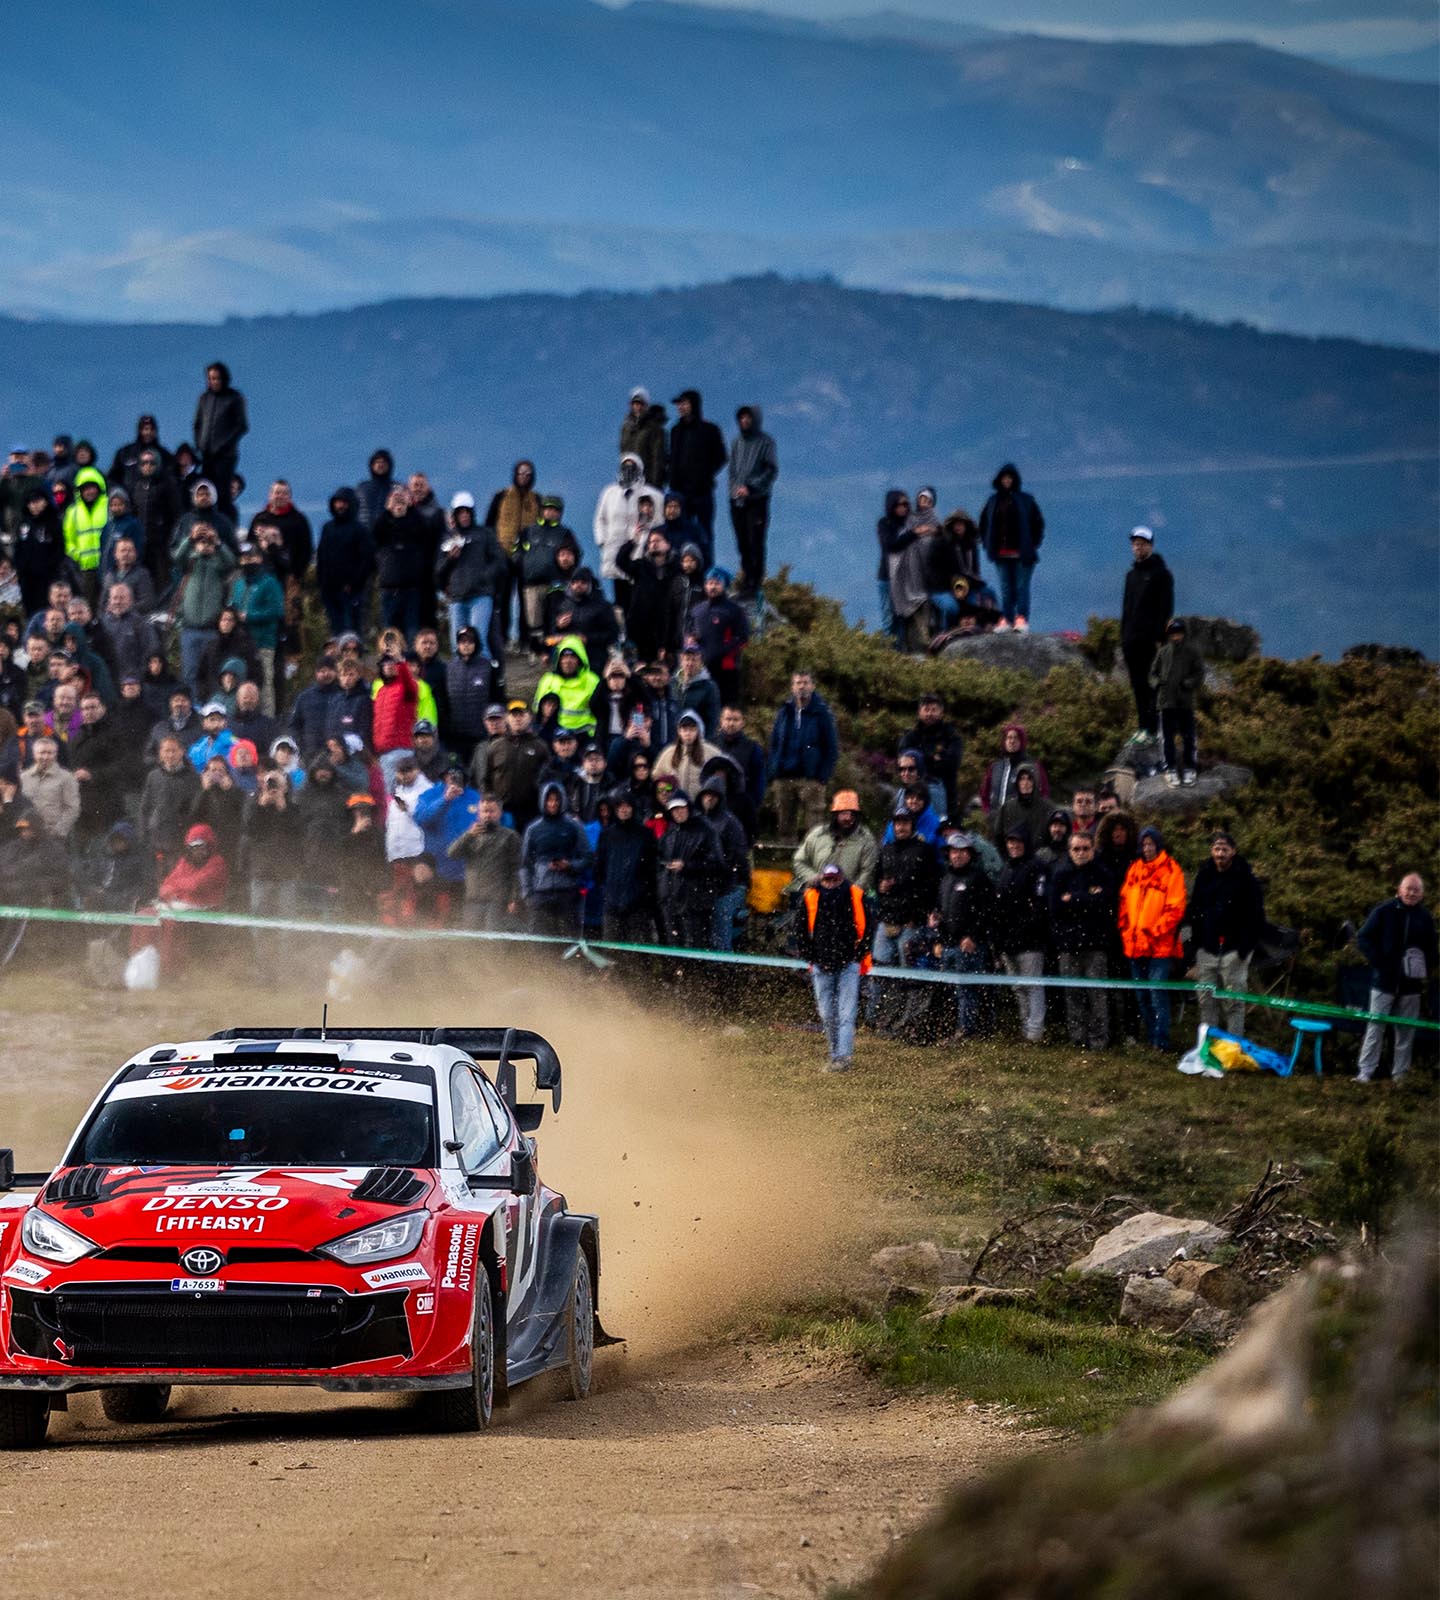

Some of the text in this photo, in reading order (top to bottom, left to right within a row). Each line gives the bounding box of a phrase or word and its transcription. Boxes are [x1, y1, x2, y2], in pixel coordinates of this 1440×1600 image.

[190, 1065, 262, 1074] TOYOTA
[266, 1064, 335, 1072] GAZOO
[339, 1067, 402, 1080] Racing
[142, 1196, 289, 1212] DENSO
[441, 1223, 464, 1288] Panasonic
[458, 1223, 479, 1292] AUTOMOTIVE
[181, 1281, 216, 1289] A-7659
